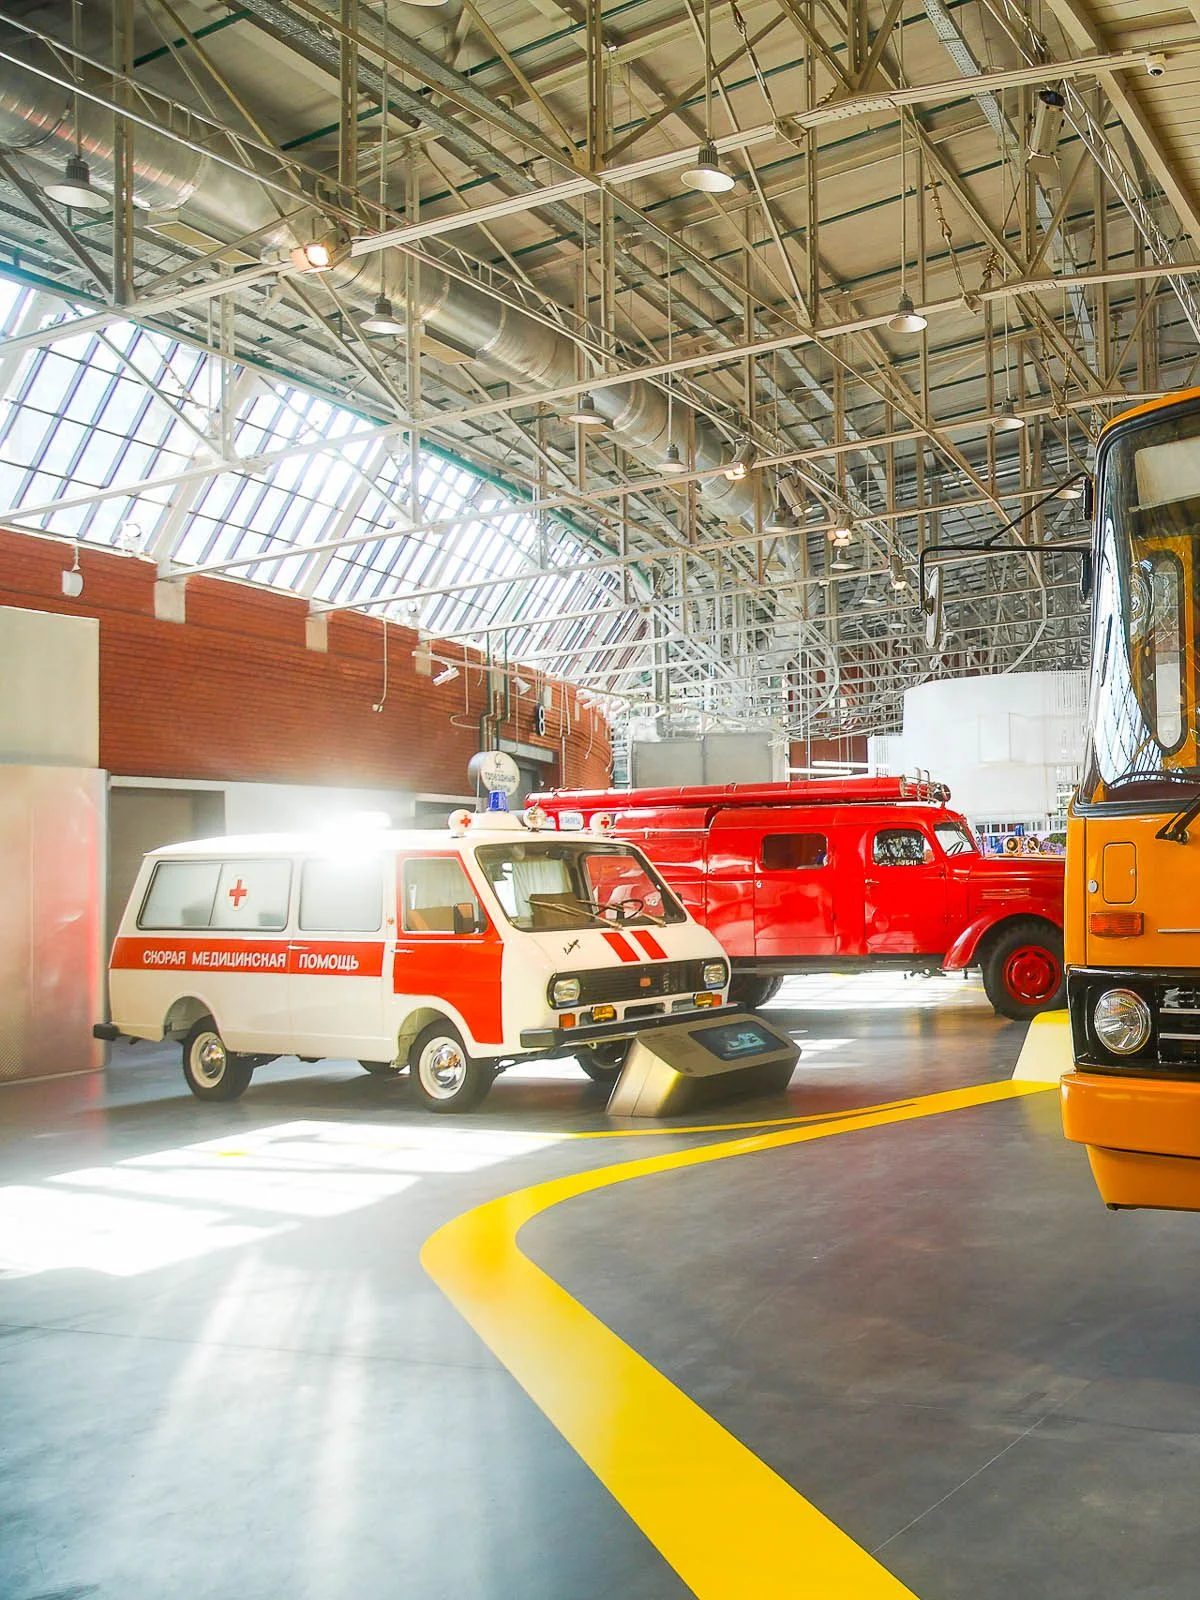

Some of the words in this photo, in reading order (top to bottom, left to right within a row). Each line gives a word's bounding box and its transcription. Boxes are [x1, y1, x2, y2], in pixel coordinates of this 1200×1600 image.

[143, 950, 186, 965] СКОРАЯ
[192, 951, 286, 968] МЕДИЦИНСКАЯ
[298, 953, 360, 971] ПОМОЩЬ
